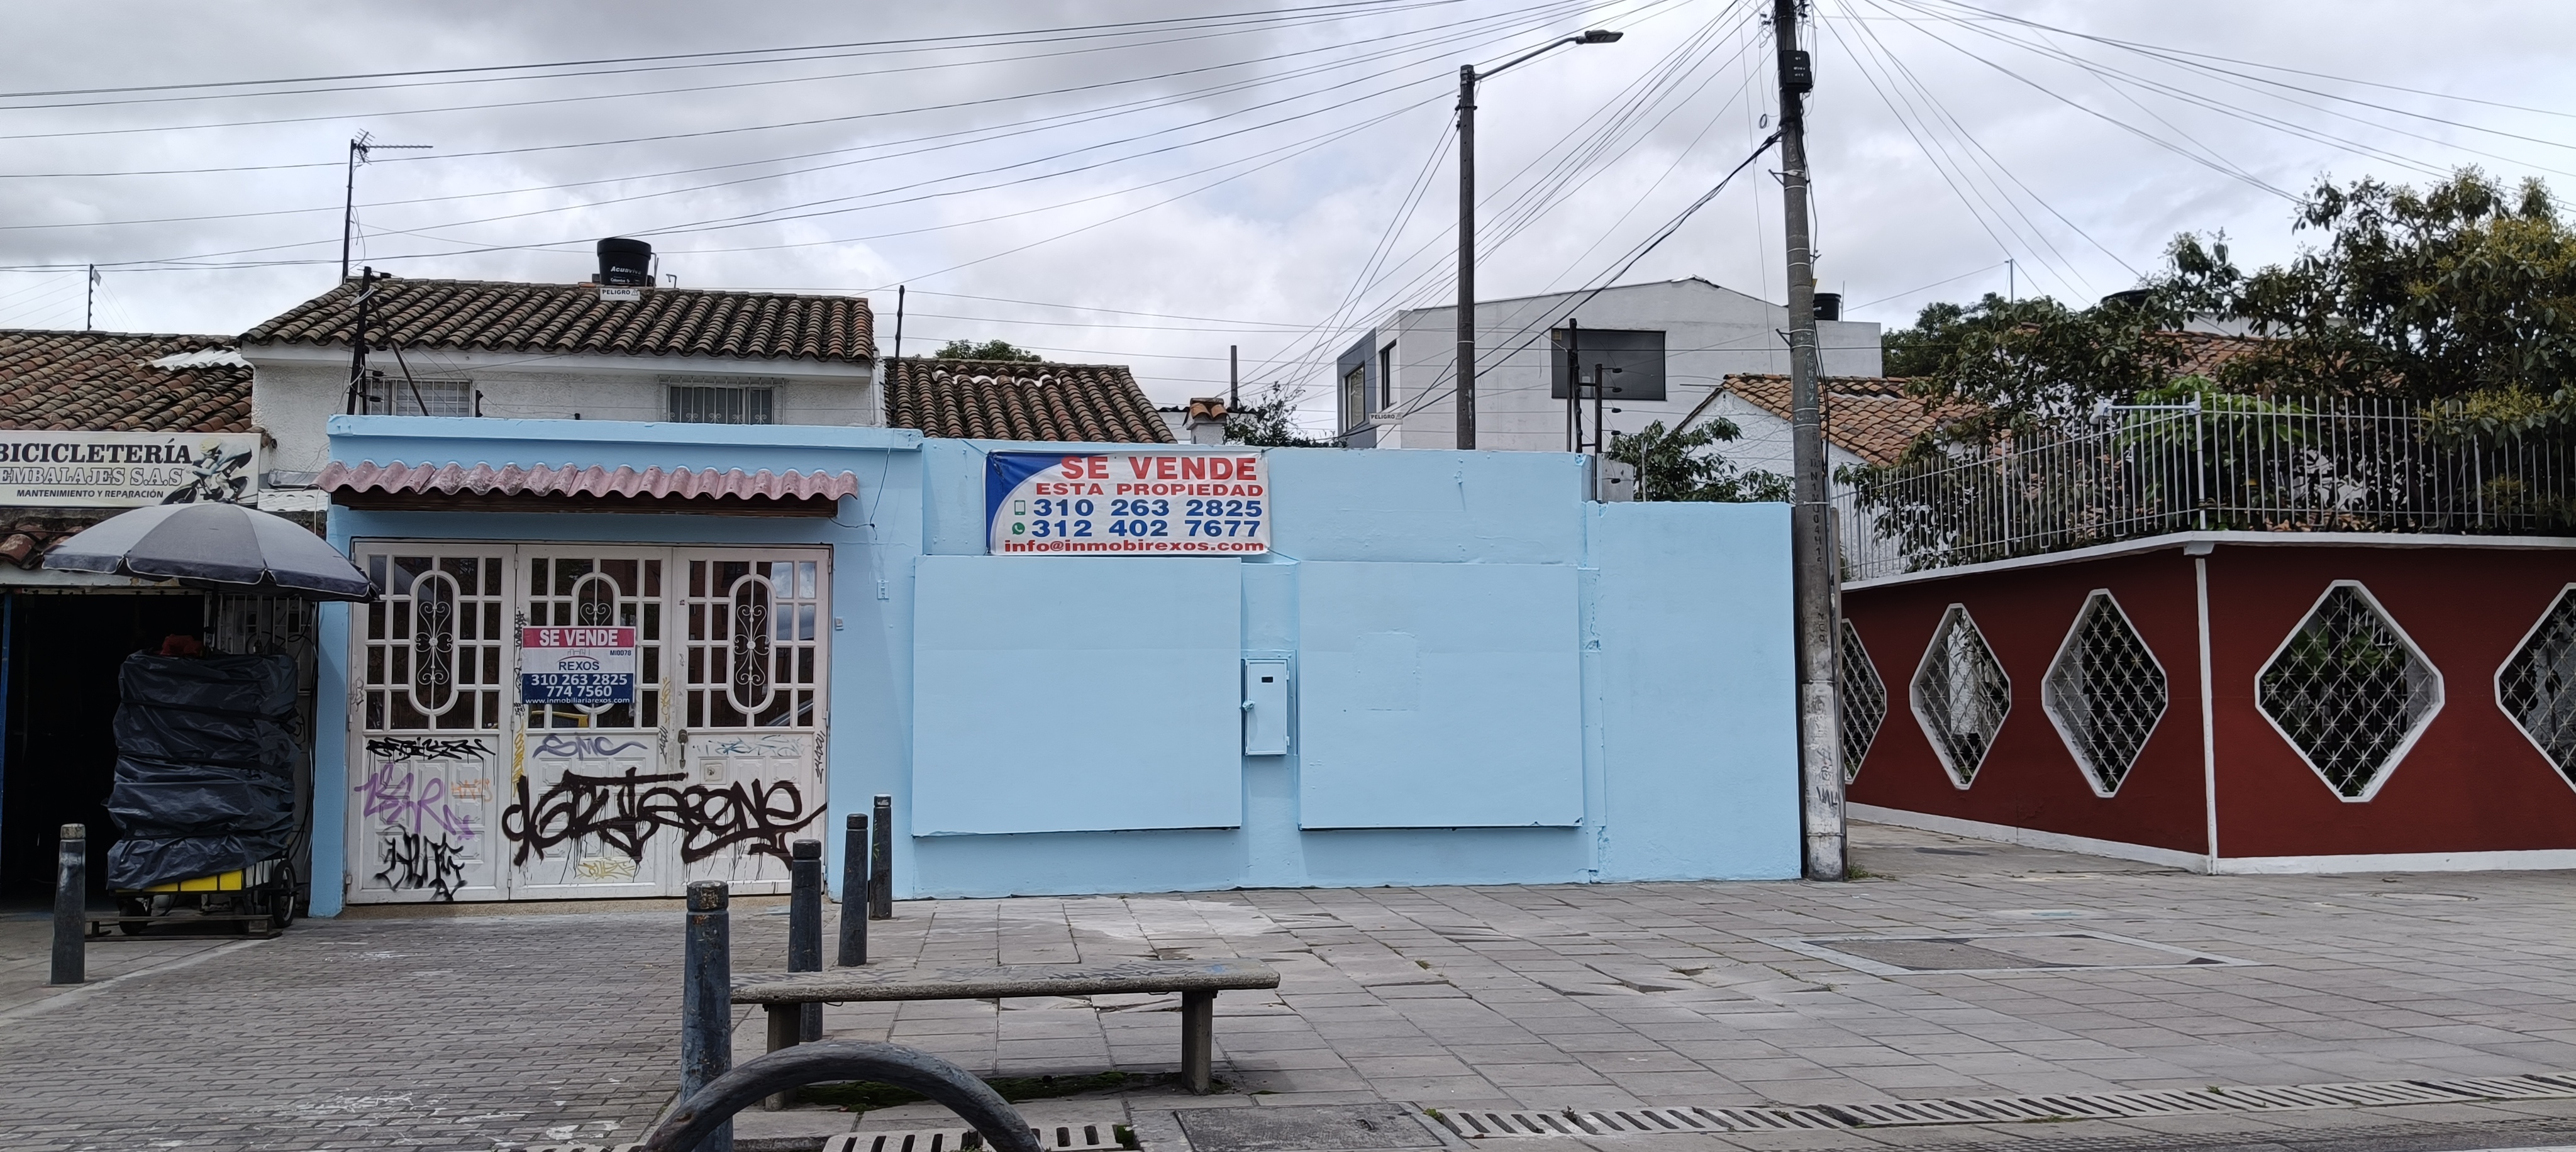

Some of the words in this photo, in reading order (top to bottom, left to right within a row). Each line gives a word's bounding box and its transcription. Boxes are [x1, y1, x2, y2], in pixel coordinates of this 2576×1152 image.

[610, 266, 641, 275] Acuaviva
[1060, 455, 1109, 480] SE
[1128, 457, 1257, 480] VENDE
[0, 467, 125, 485] EMBALAJES
[130, 467, 184, 485] S.A.S
[17, 489, 95, 497] MANTENIMIENTO
[104, 489, 164, 498] REPARACIÓN
[1036, 483, 1104, 496] ESTA
[1116, 484, 1263, 497] PROPIEDAD
[1033, 499, 1094, 516] 310
[1111, 499, 1170, 516] 263
[1185, 500, 1262, 518] 2825
[1031, 520, 1092, 537] 312
[1109, 520, 1168, 537] 402
[1184, 520, 1260, 537] 7677
[1005, 539, 1264, 553] info@inmobirexos.com
[539, 629, 560, 646] SE
[564, 629, 618, 646] VENDE
[558, 662, 600, 671] REXOS
[531, 675, 558, 685] 310
[562, 675, 588, 685] 263
[592, 675, 628, 685] 2825
[547, 686, 572, 697] 774
[577, 686, 612, 697] 7560
